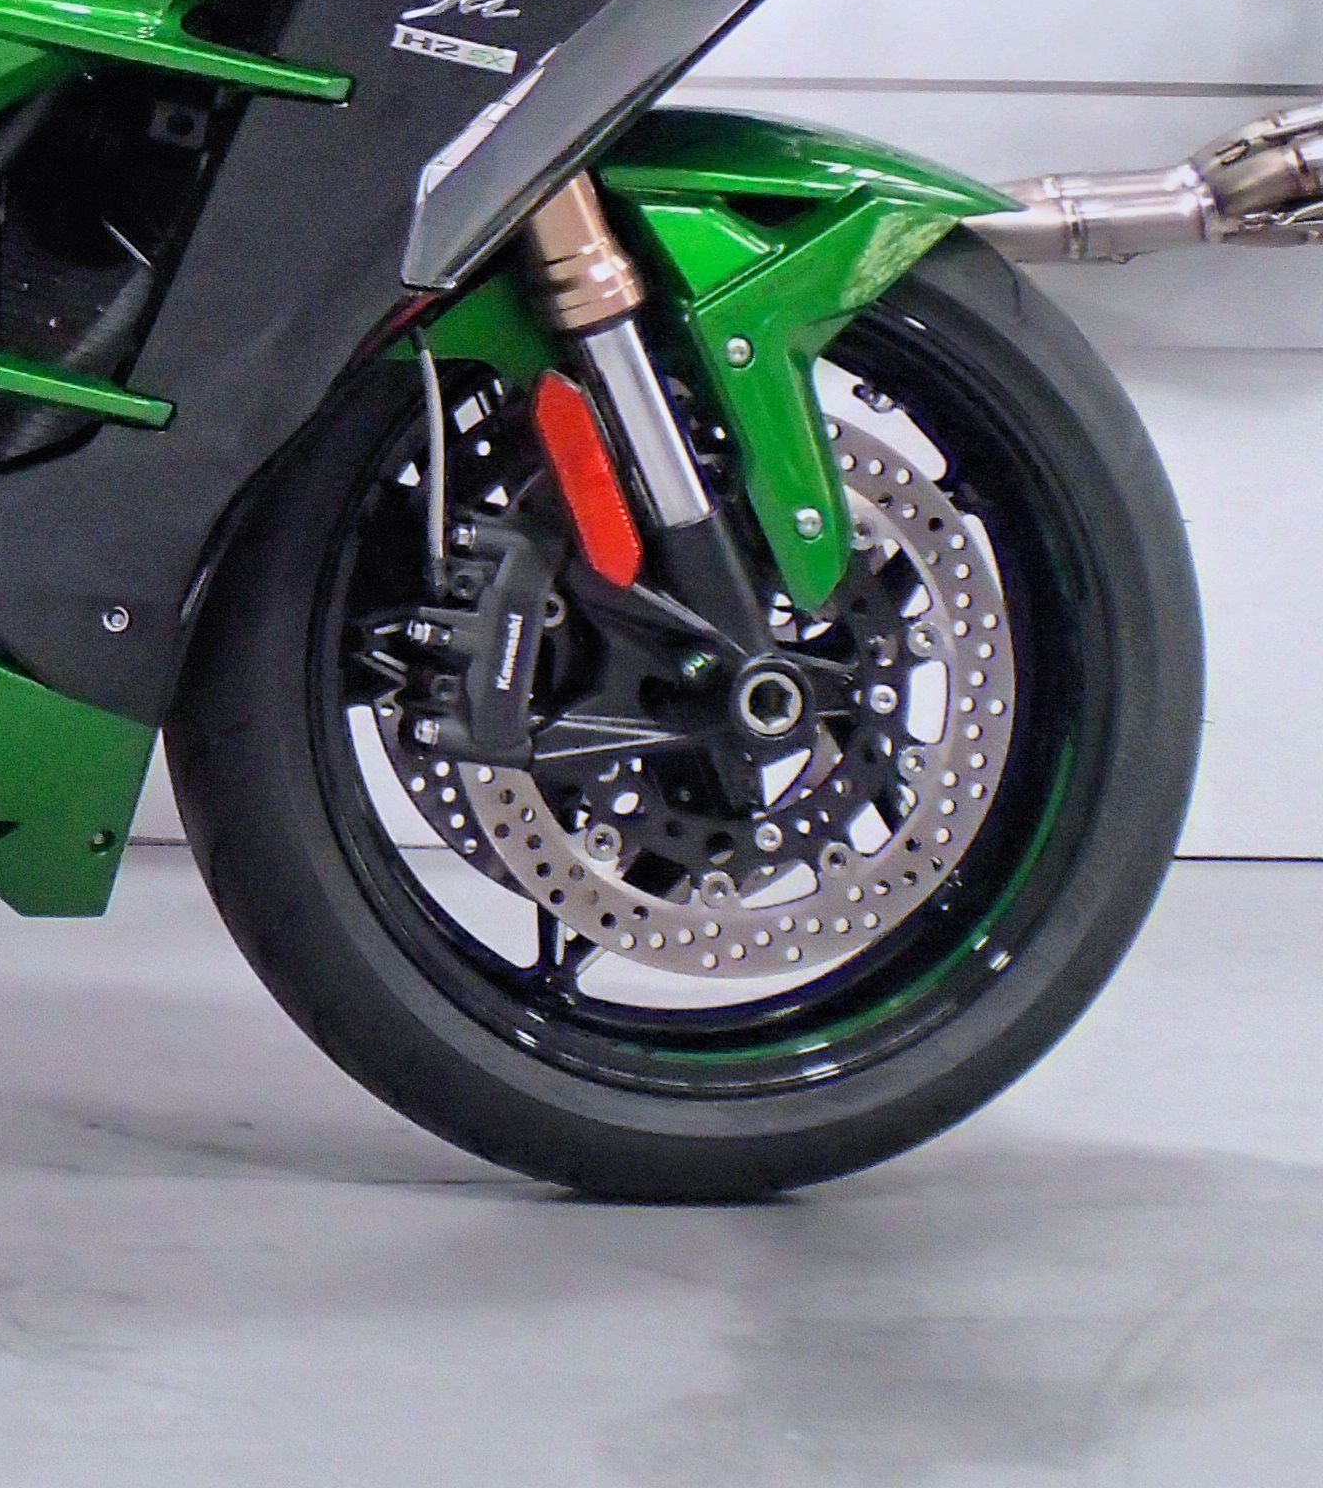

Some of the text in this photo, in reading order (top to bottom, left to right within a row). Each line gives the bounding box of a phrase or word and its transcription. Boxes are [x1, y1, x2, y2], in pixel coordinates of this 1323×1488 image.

[401, 32, 501, 67] H2 SX
[496, 613, 523, 691] Kawasaki
